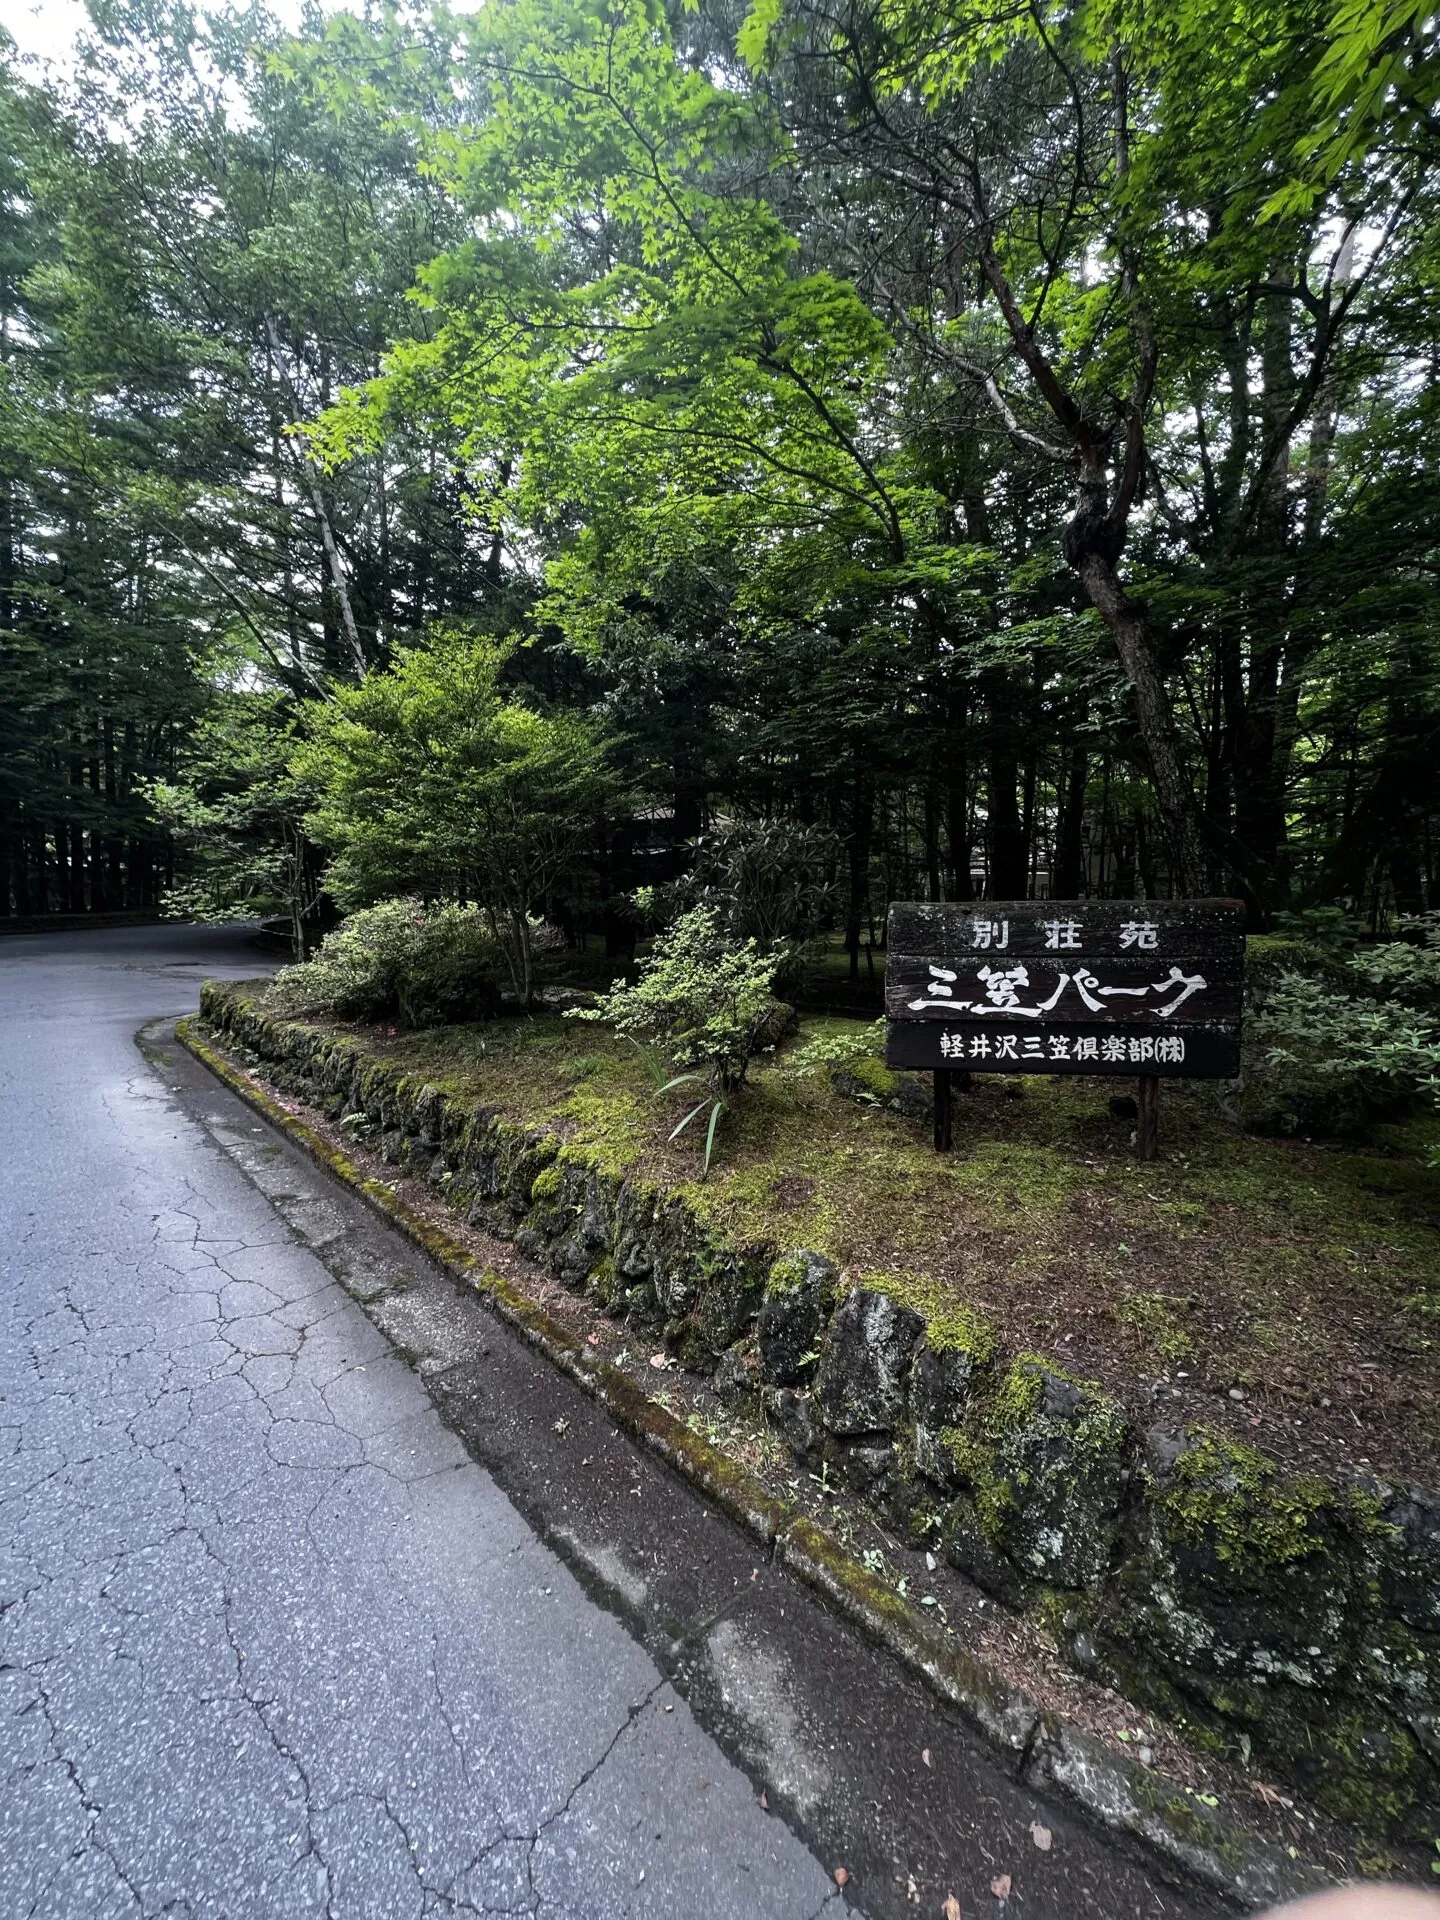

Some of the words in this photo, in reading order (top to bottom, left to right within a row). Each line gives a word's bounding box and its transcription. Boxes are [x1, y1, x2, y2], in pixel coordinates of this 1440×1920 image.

[971, 919, 1159, 949] 別荘苑
[906, 964, 1208, 1017] 三笠パーク
